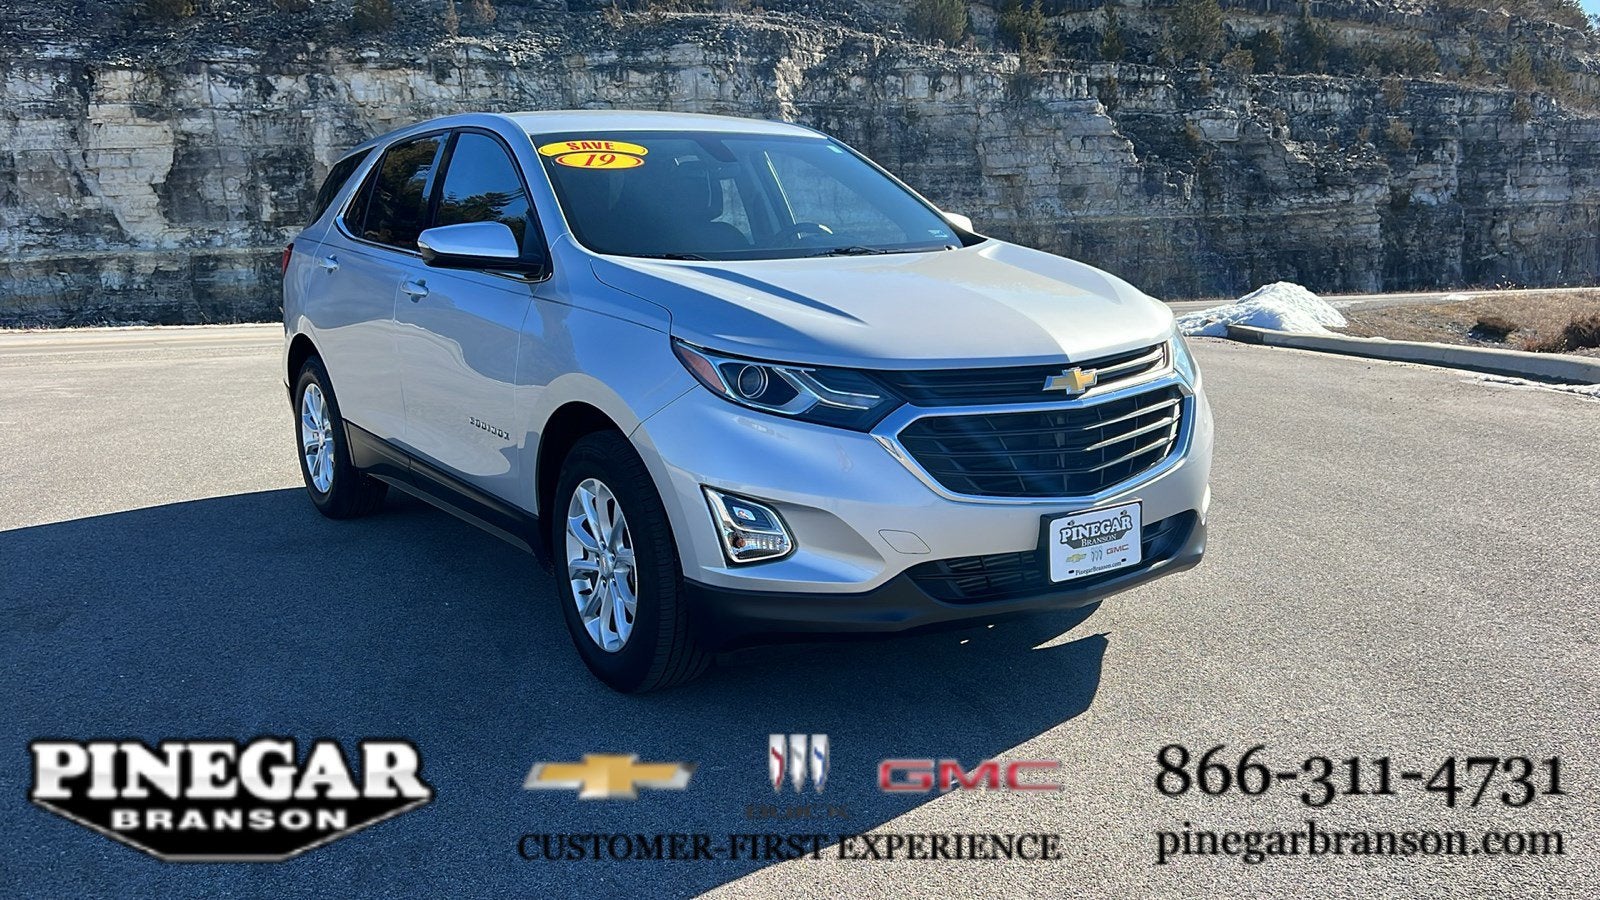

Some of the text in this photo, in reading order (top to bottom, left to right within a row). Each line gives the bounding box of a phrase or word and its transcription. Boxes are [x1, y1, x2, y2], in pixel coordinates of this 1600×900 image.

[566, 142, 615, 150] SAVE
[584, 154, 616, 166] 19
[469, 416, 510, 440] EQUINOX
[1060, 515, 1133, 543] PINEGAR
[1106, 544, 1129, 555] GMC
[1075, 561, 1122, 576] PinegarBranson.com
